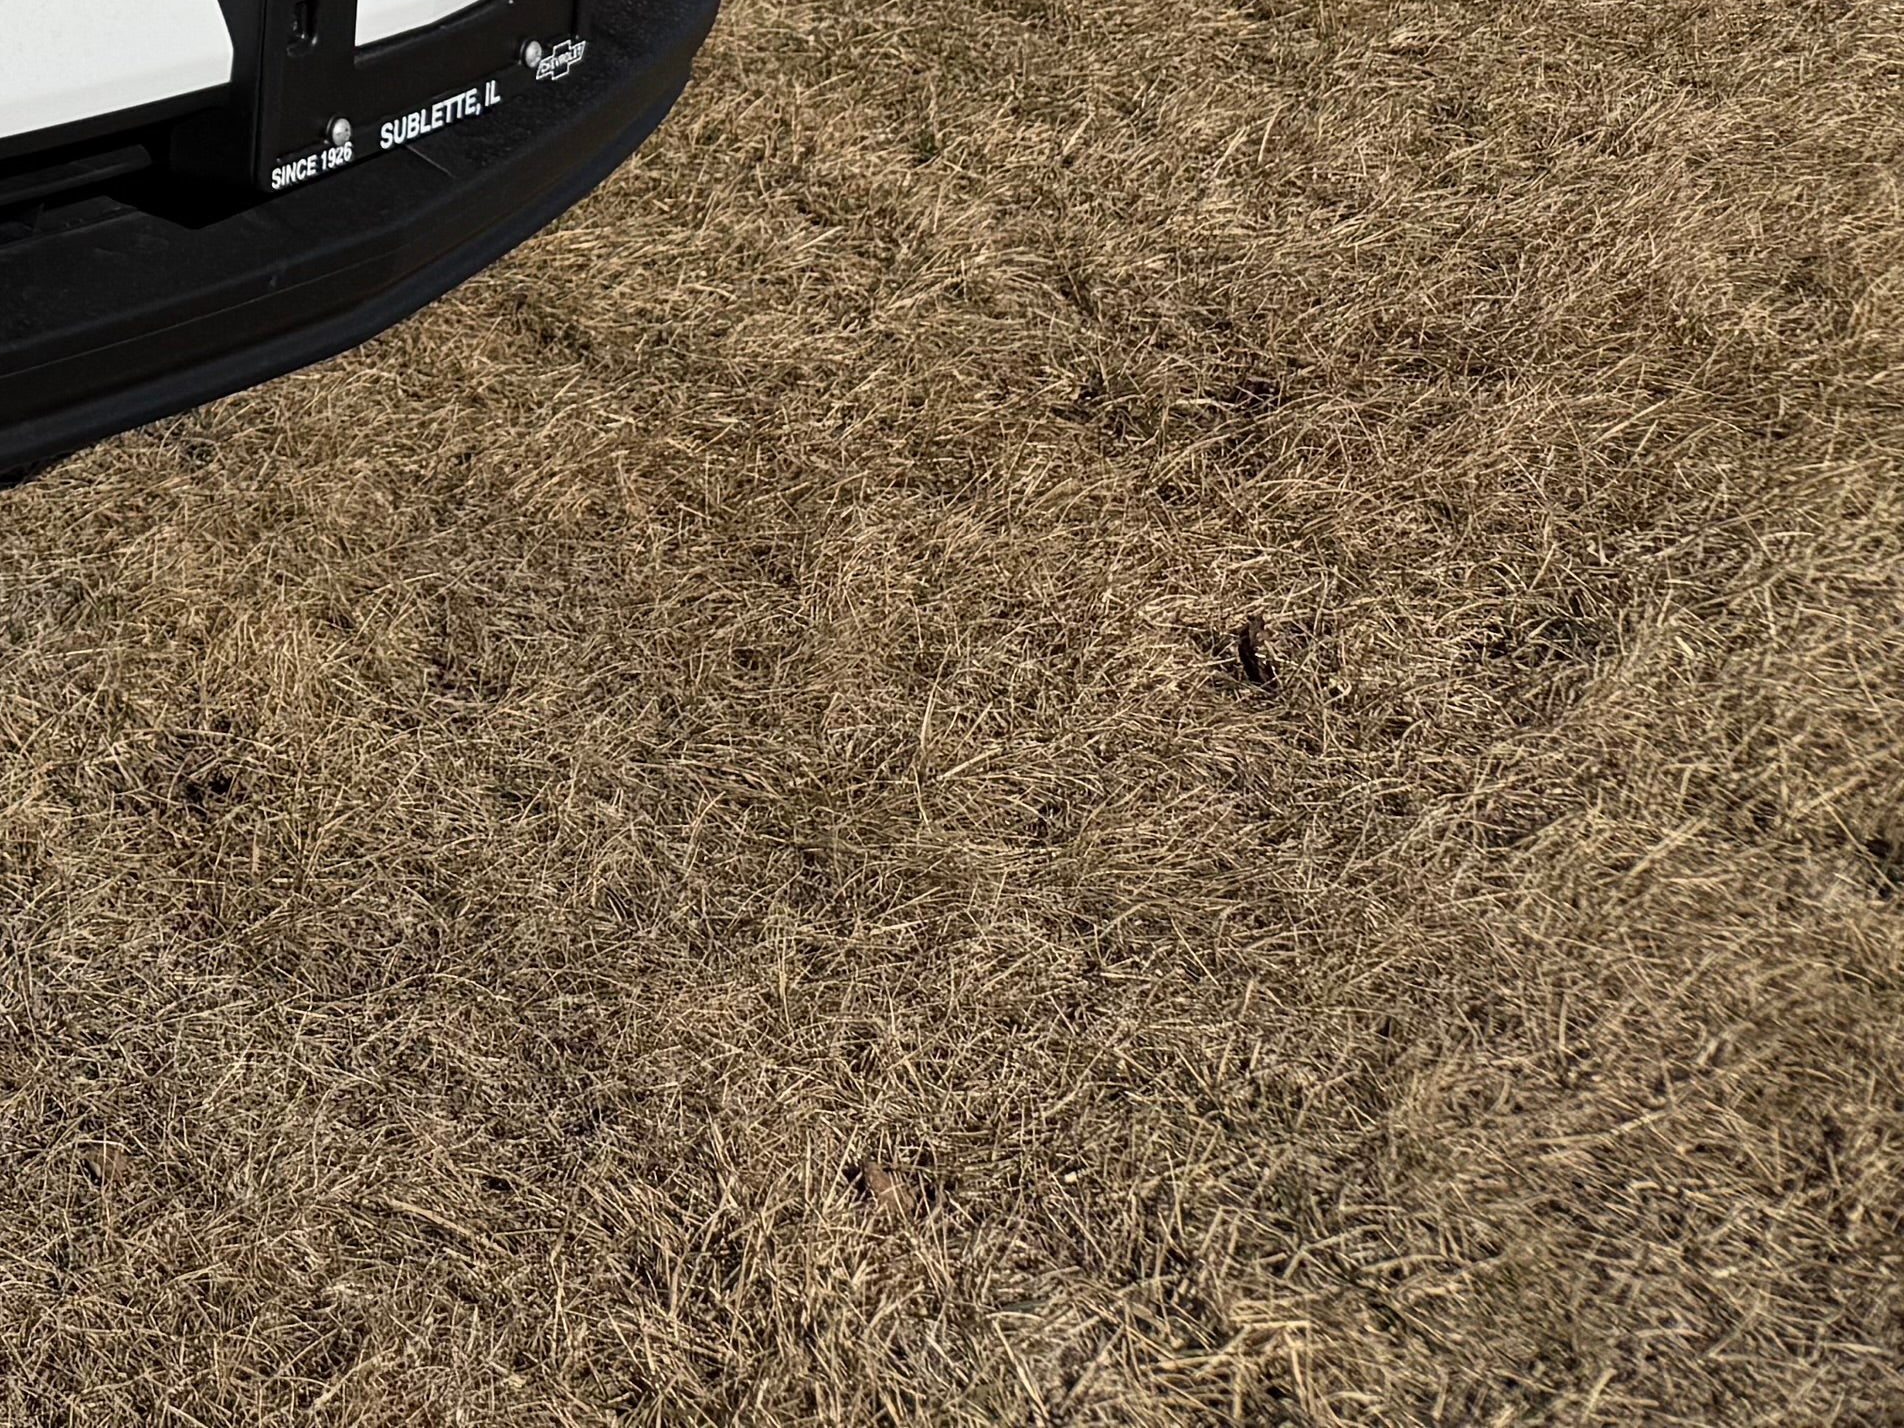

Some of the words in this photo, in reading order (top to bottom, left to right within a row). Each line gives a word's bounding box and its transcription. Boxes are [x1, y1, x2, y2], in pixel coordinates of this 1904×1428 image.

[380, 87, 482, 149] SUBLETTE,
[483, 79, 502, 107] IL
[271, 156, 317, 190] SINCE
[319, 141, 353, 173] 1926
